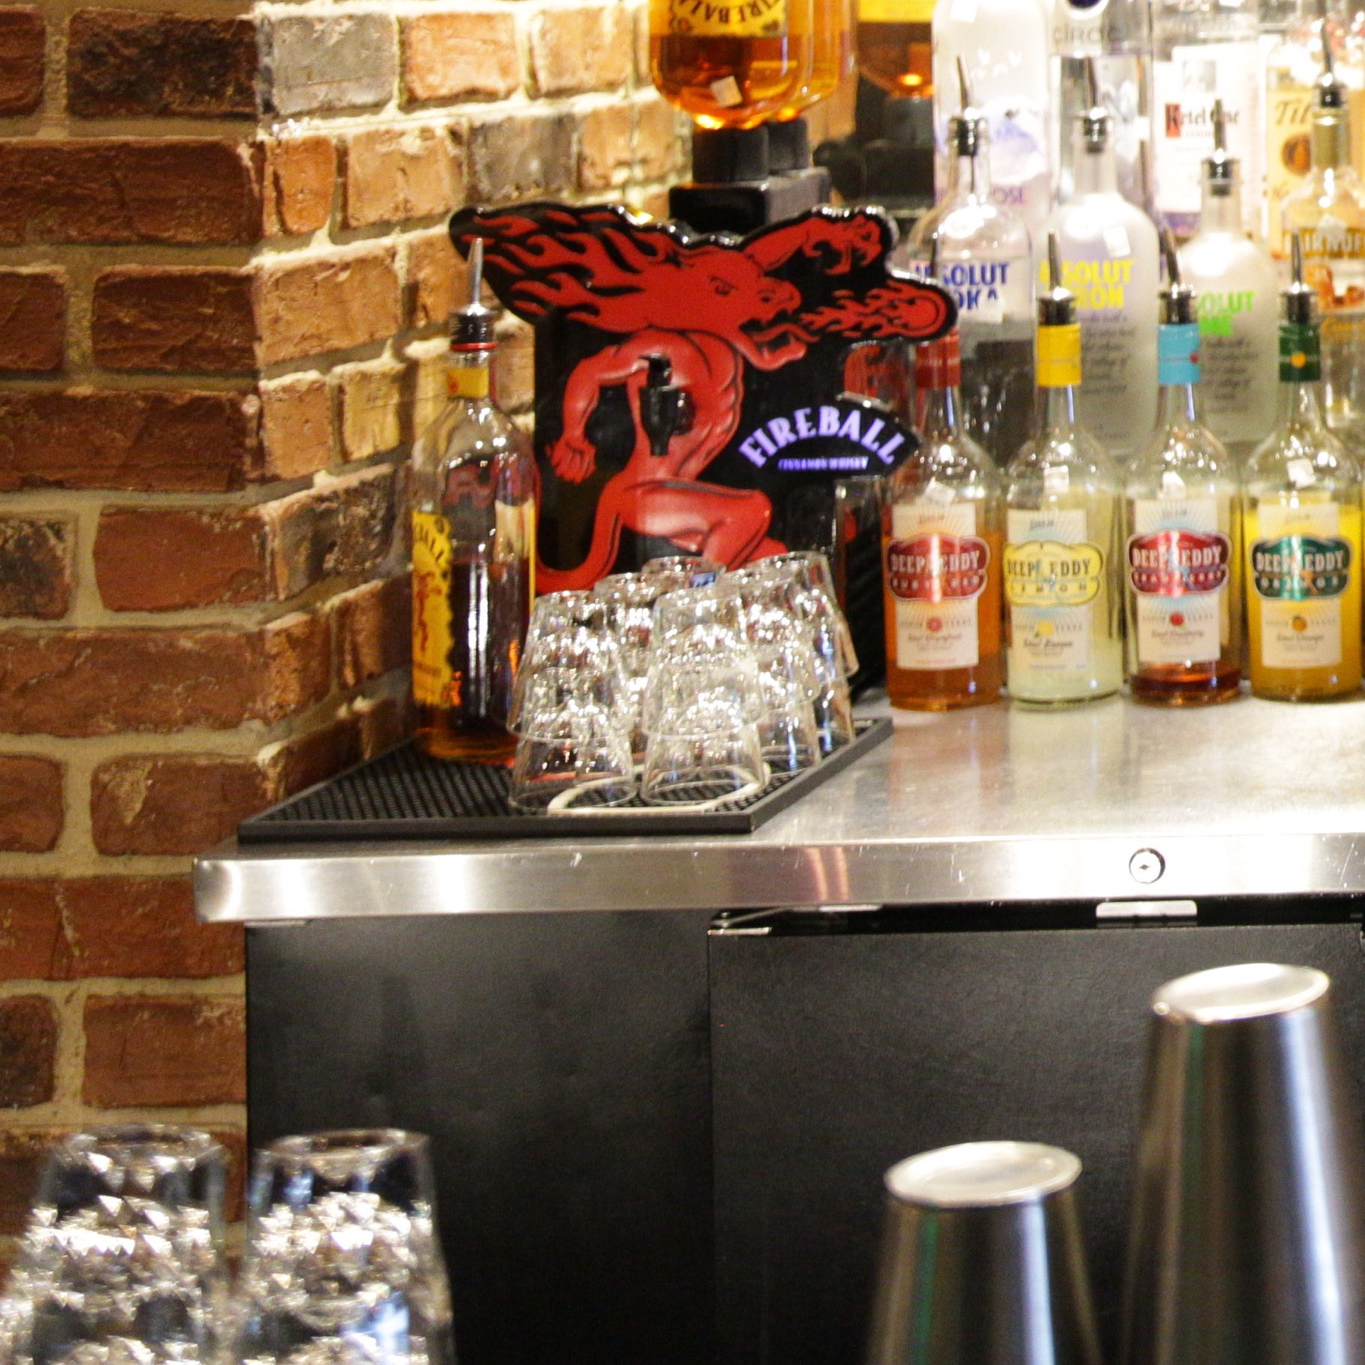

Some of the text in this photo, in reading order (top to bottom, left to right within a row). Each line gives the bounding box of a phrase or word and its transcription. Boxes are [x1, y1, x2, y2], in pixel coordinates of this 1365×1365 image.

[1165, 104, 1207, 131] Ketel
[1275, 98, 1312, 126] Tit
[1040, 259, 1135, 285] ASOLUT
[1073, 284, 1125, 310] RON
[1197, 291, 1256, 314] OLUT
[738, 405, 906, 468] FIREBALL
[890, 549, 980, 574] DEEP EDDY
[1007, 557, 1092, 578] DEEP EDDY
[1132, 544, 1223, 568] DEEP EDDY
[1255, 549, 1344, 574] DEEP EDDY
